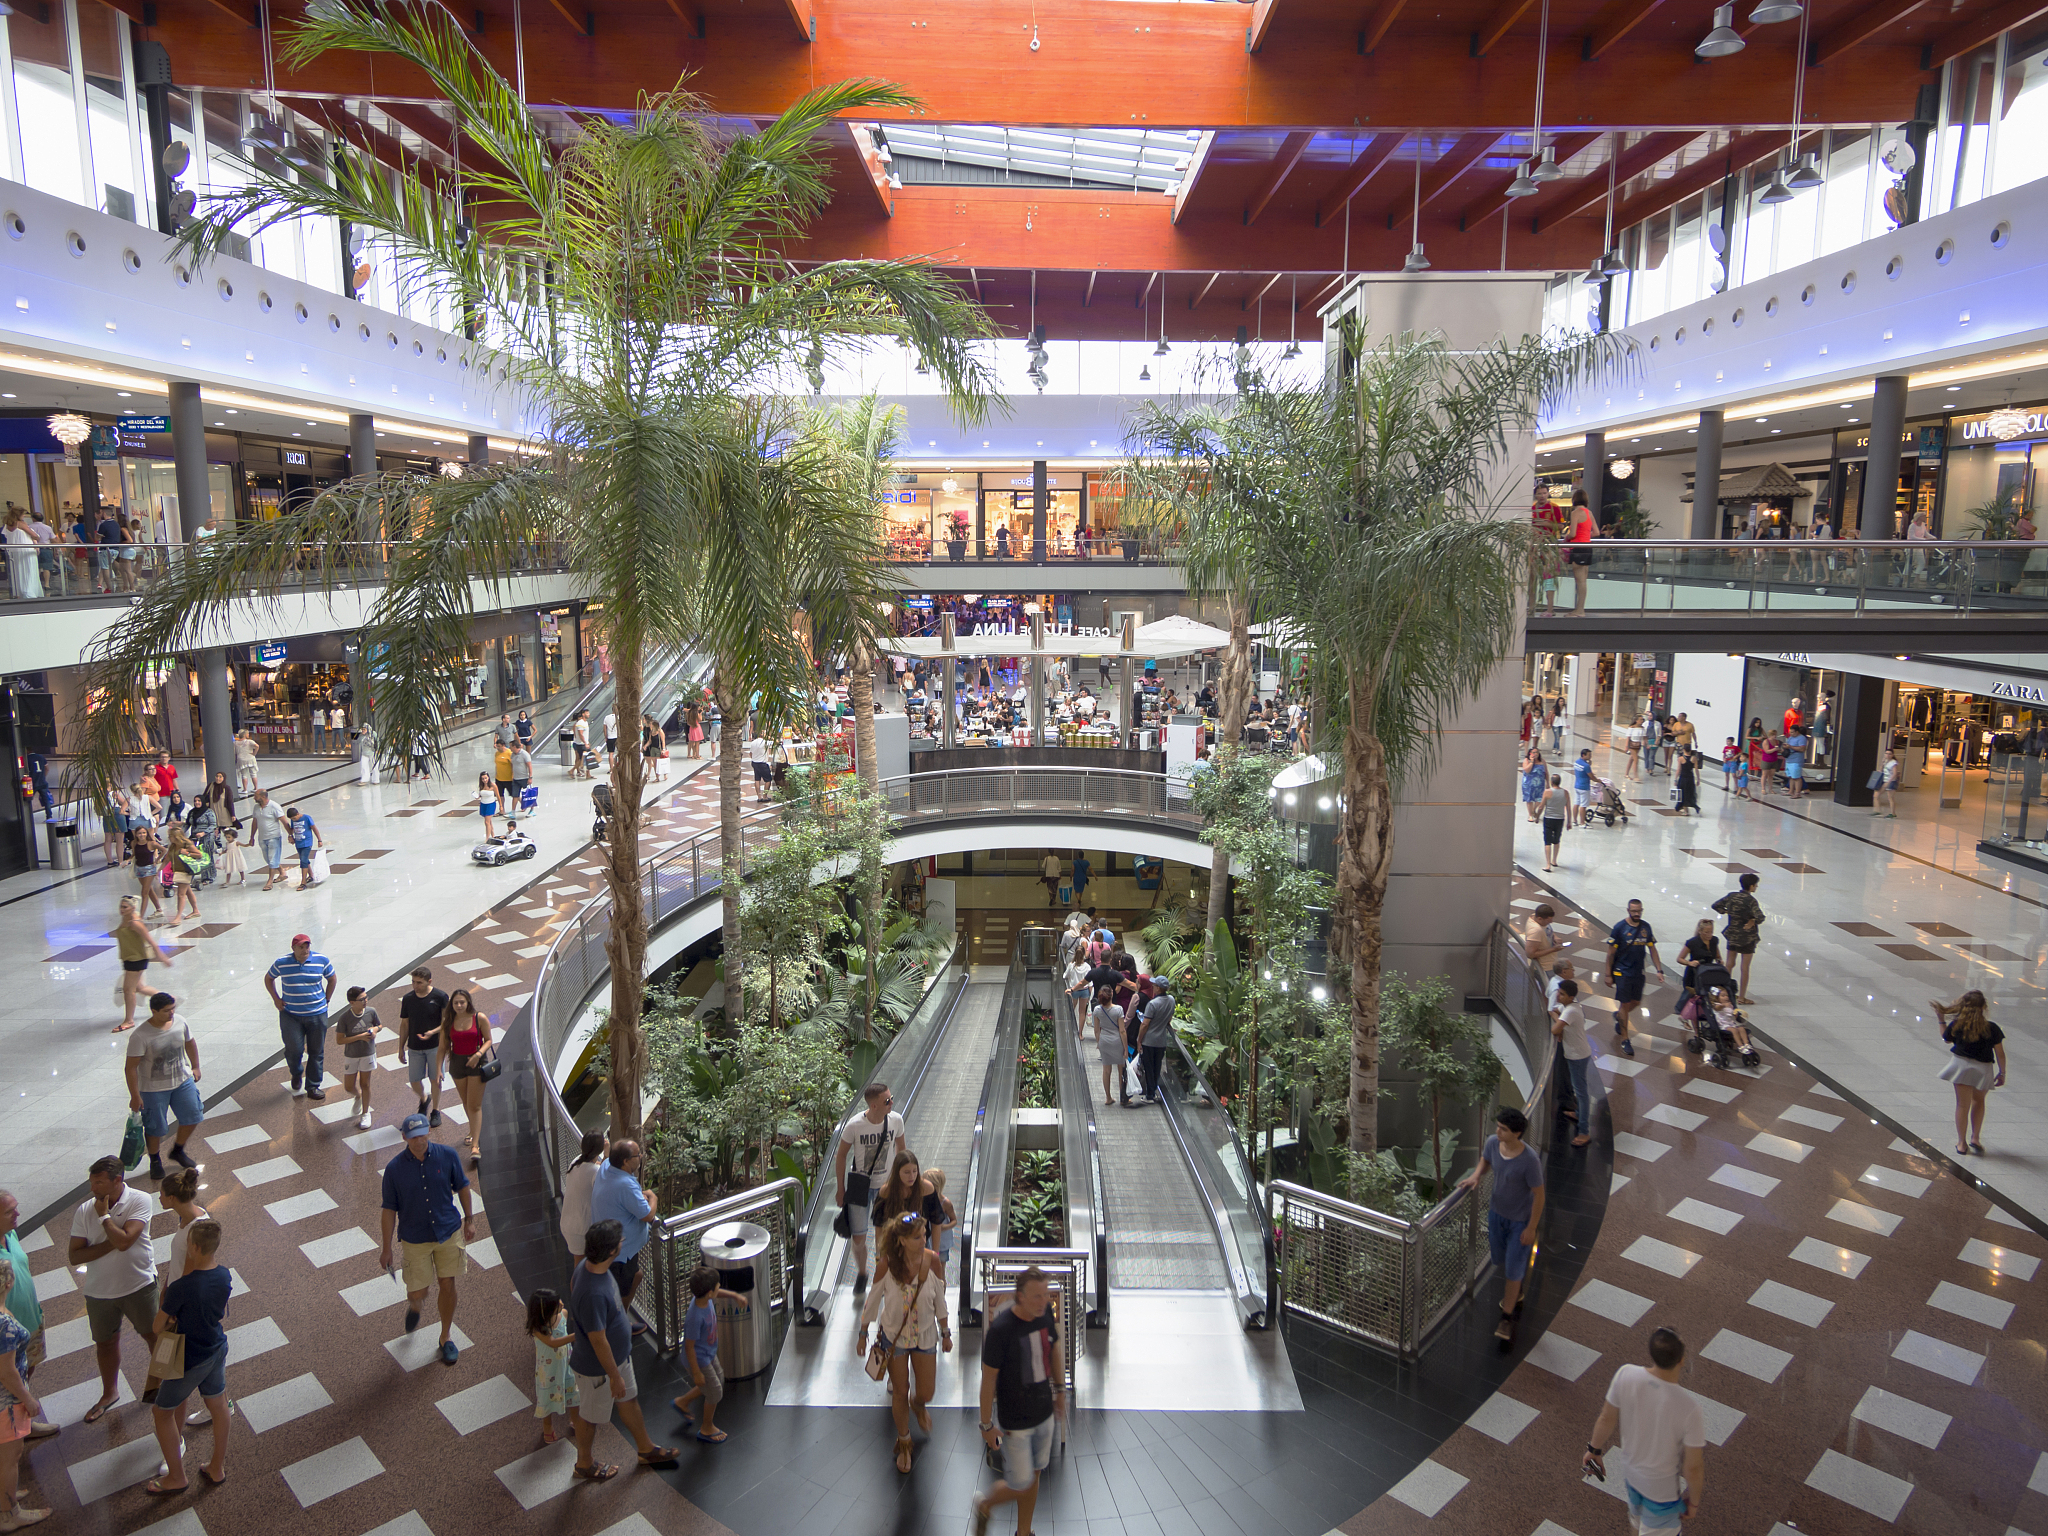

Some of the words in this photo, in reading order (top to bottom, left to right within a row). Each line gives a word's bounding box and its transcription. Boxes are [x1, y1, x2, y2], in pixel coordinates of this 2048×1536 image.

[1778, 652, 1811, 664] ZARA
[1991, 681, 2046, 702] ZARA
[1695, 698, 1712, 707] ZARA
[258, 726, 273, 734] TODO
[274, 726, 281, 734] AL
[34, 760, 42, 773] 1
[859, 1129, 895, 1146] MONEY
